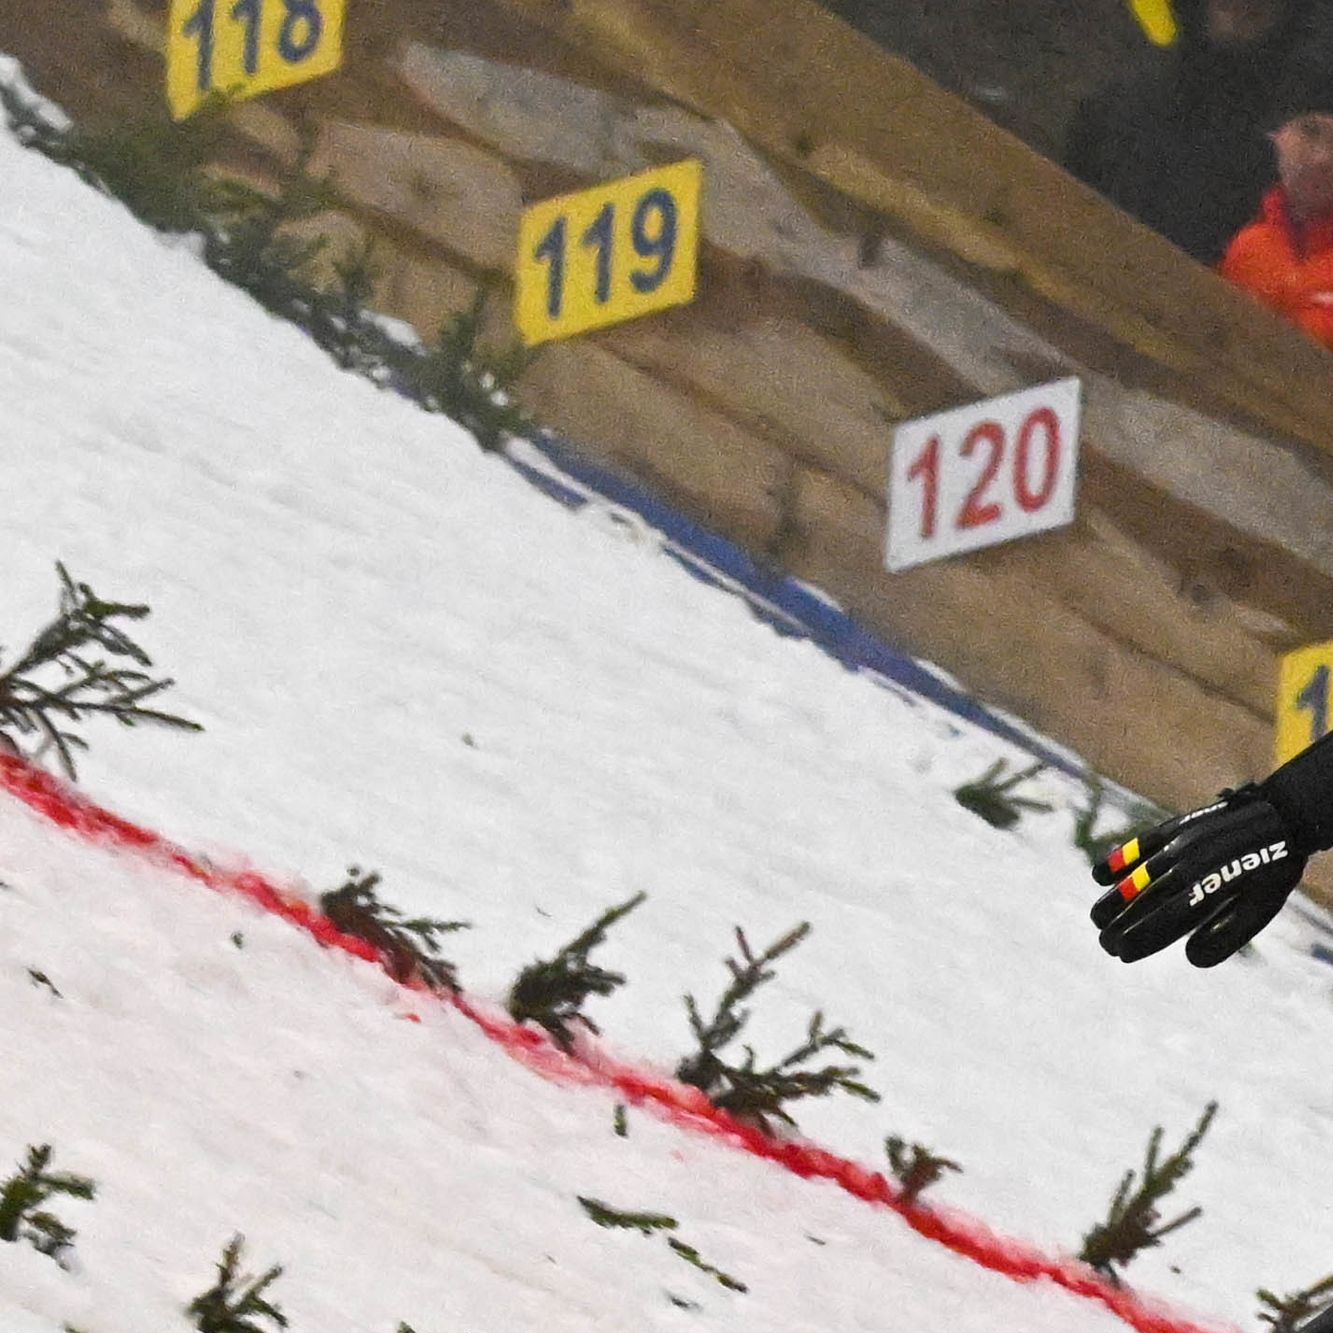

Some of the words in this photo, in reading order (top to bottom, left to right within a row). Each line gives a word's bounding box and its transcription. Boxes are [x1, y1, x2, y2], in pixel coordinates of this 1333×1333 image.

[183, 0, 322, 91] 118
[534, 188, 678, 320] 119
[906, 408, 1061, 537] 120
[1189, 840, 1288, 907] ziener
